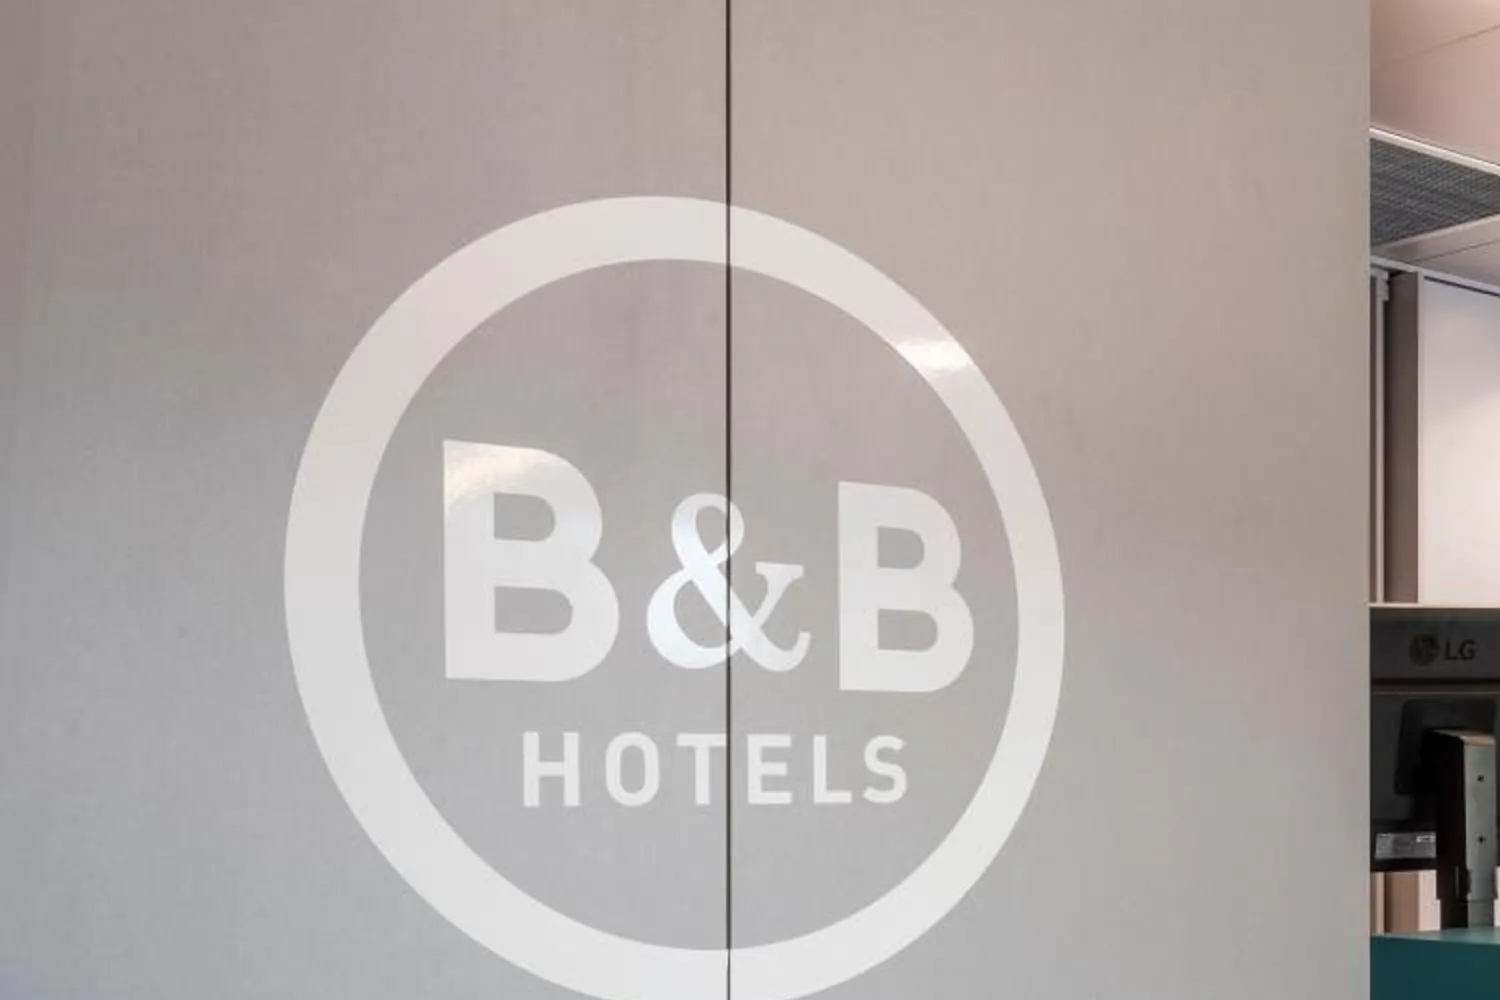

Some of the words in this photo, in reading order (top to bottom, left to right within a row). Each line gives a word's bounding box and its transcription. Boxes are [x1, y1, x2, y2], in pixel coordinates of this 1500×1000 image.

[442, 439, 975, 693] B&B
[1445, 638, 1477, 660] LG
[523, 731, 908, 807] HOTELS
